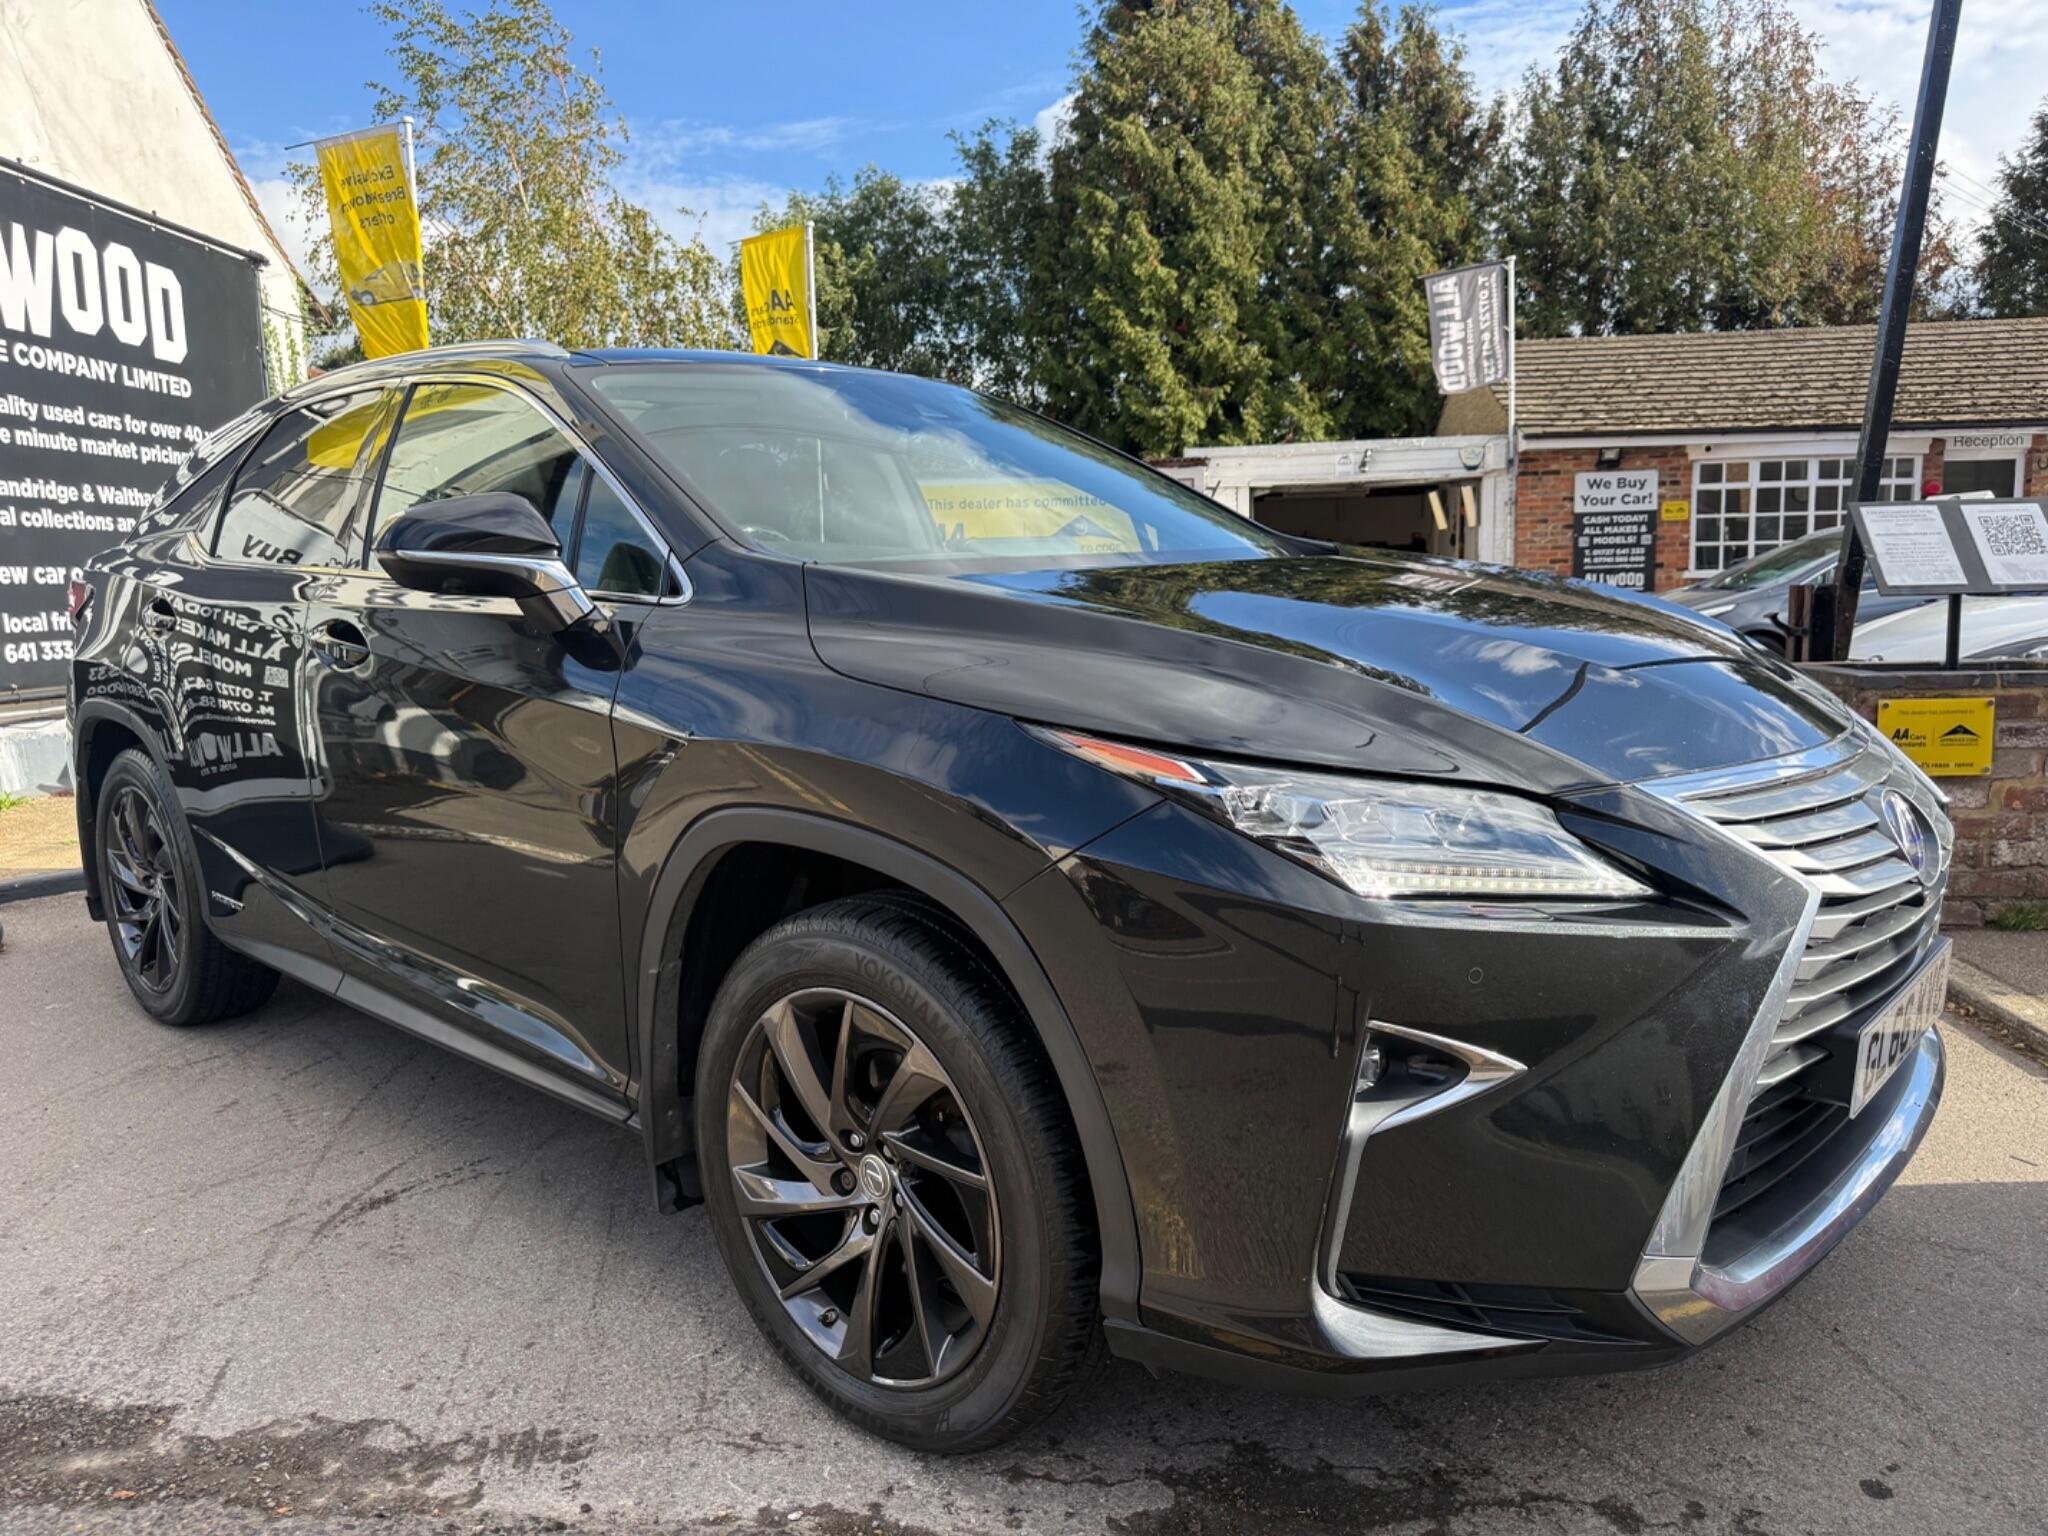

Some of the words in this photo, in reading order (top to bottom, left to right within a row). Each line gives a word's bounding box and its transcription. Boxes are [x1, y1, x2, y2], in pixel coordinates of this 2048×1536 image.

[13, 342, 118, 384] COMPANY
[121, 365, 192, 398] LIMITED
[42, 406, 85, 426] used
[88, 412, 122, 431] cars
[124, 414, 148, 435] for
[150, 421, 182, 440] over
[184, 425, 203, 443] 40
[14, 427, 79, 453] minute
[81, 438, 138, 460] market
[1953, 434, 2025, 449] Reception
[1586, 478, 1612, 490] We
[1616, 477, 1648, 490] Buy
[82, 484, 95, 503] &
[96, 485, 156, 508] Waltha
[928, 498, 954, 510] This
[959, 497, 1000, 510] dealer
[1006, 495, 1029, 509] has
[1580, 494, 1616, 506] Your
[1621, 492, 1653, 505] Car!
[20, 507, 115, 532] collections
[117, 517, 138, 533] an
[1583, 515, 1611, 525] CASH
[1612, 514, 1648, 524] TODAY!
[1583, 526, 1602, 535] ALL
[1604, 525, 1638, 535] MAKES
[1593, 535, 1637, 546] MODELS!
[33, 566, 67, 584] car
[2, 611, 48, 633] local
[51, 612, 72, 631] fri
[5, 641, 38, 663] 641
[39, 640, 75, 661] 333
[1892, 728, 1909, 740] AA
